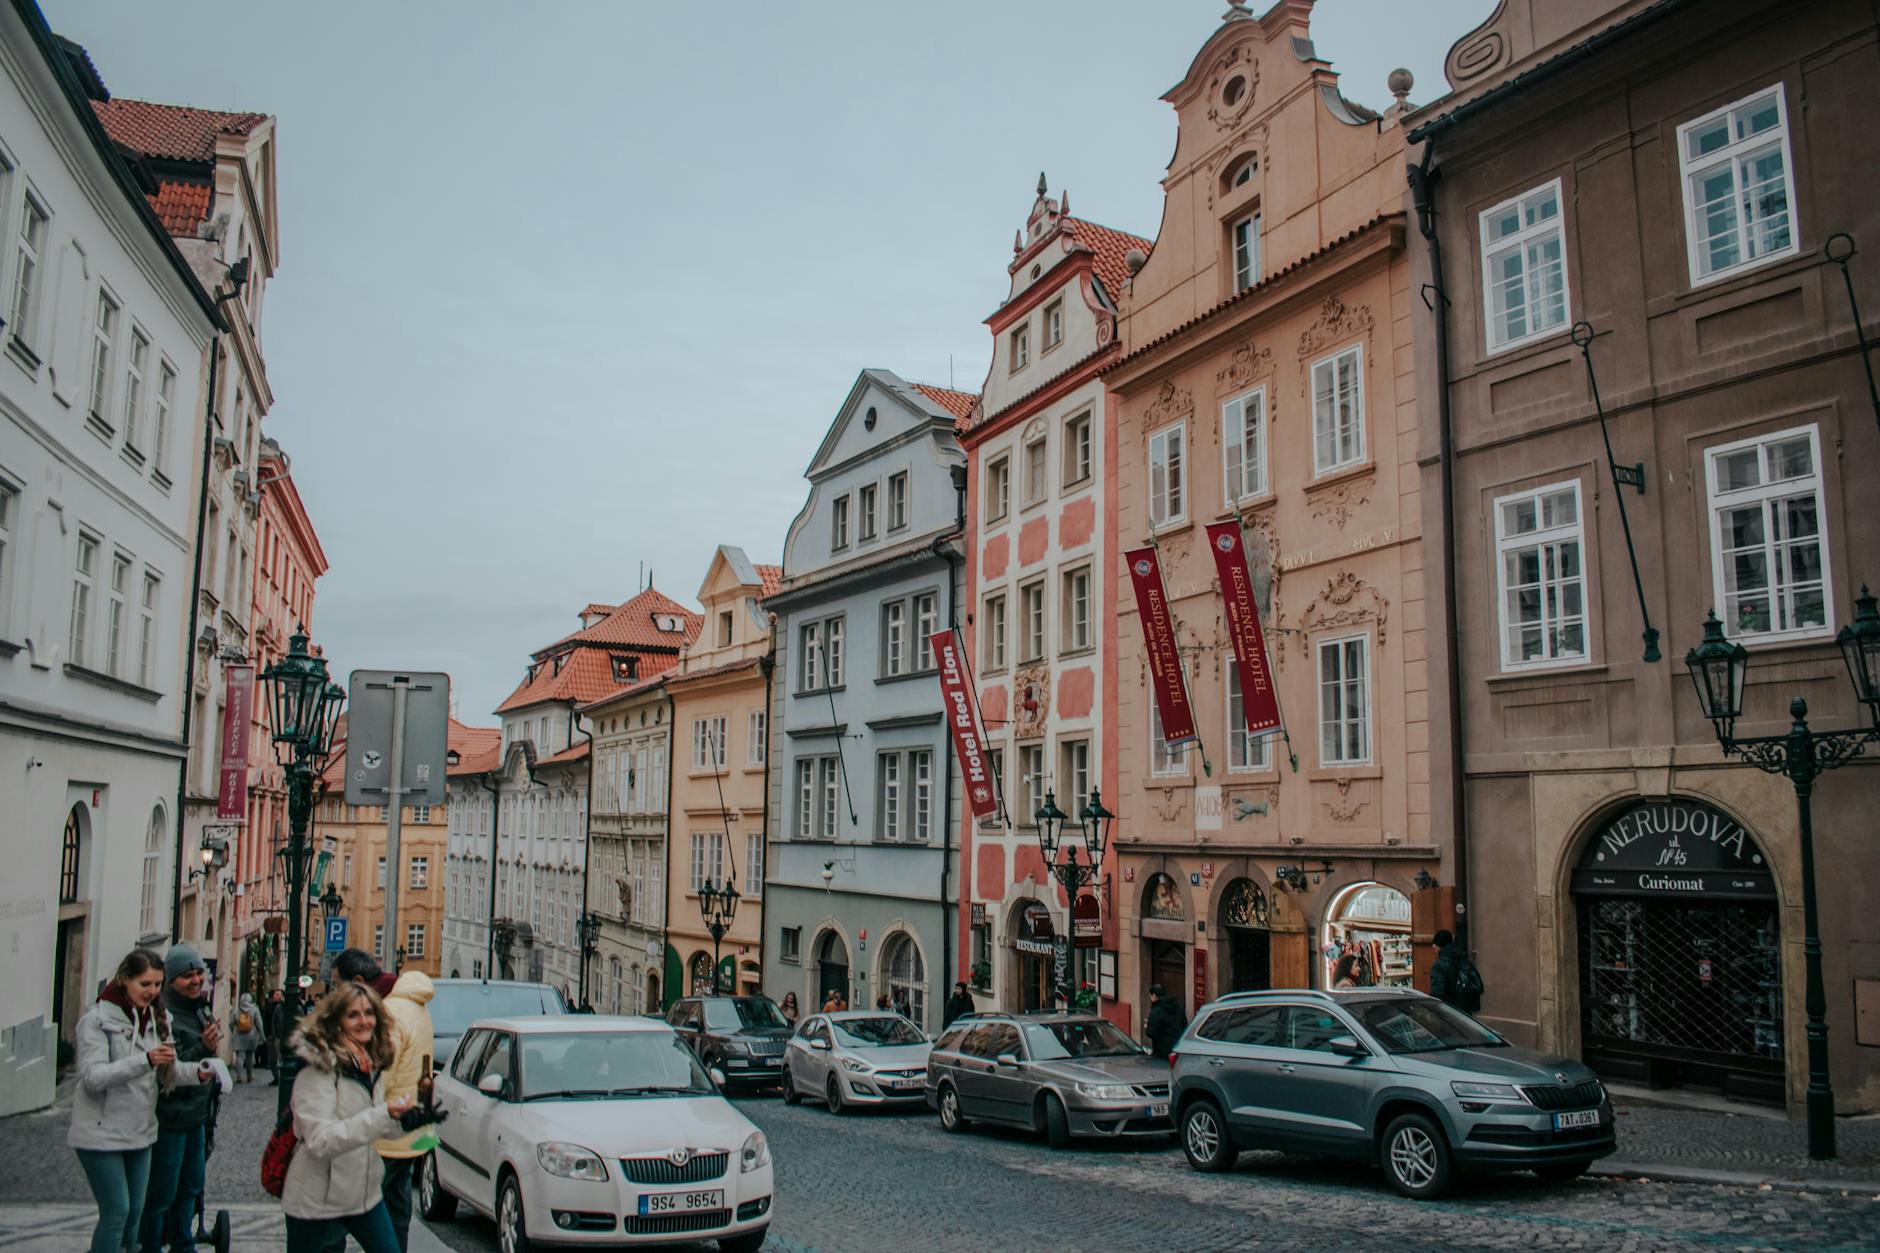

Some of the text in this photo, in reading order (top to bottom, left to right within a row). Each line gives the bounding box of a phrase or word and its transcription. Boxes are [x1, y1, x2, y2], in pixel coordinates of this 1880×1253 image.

[1148, 589, 1183, 706] RESIDENCE HOTEL
[1231, 566, 1267, 695] RESIDENCE HOTEL
[231, 690, 242, 755] RESIDENCE
[943, 646, 985, 782] Hotel Red Lion
[228, 772, 238, 809] HOTEL
[1602, 807, 1745, 859] NERUDOVA
[1669, 835, 1680, 848] ul.
[1638, 874, 1704, 891] Curiomat
[330, 922, 343, 941] P
[1016, 939, 1053, 955] RESTAURANT
[651, 1192, 717, 1211] 9S4 9654
